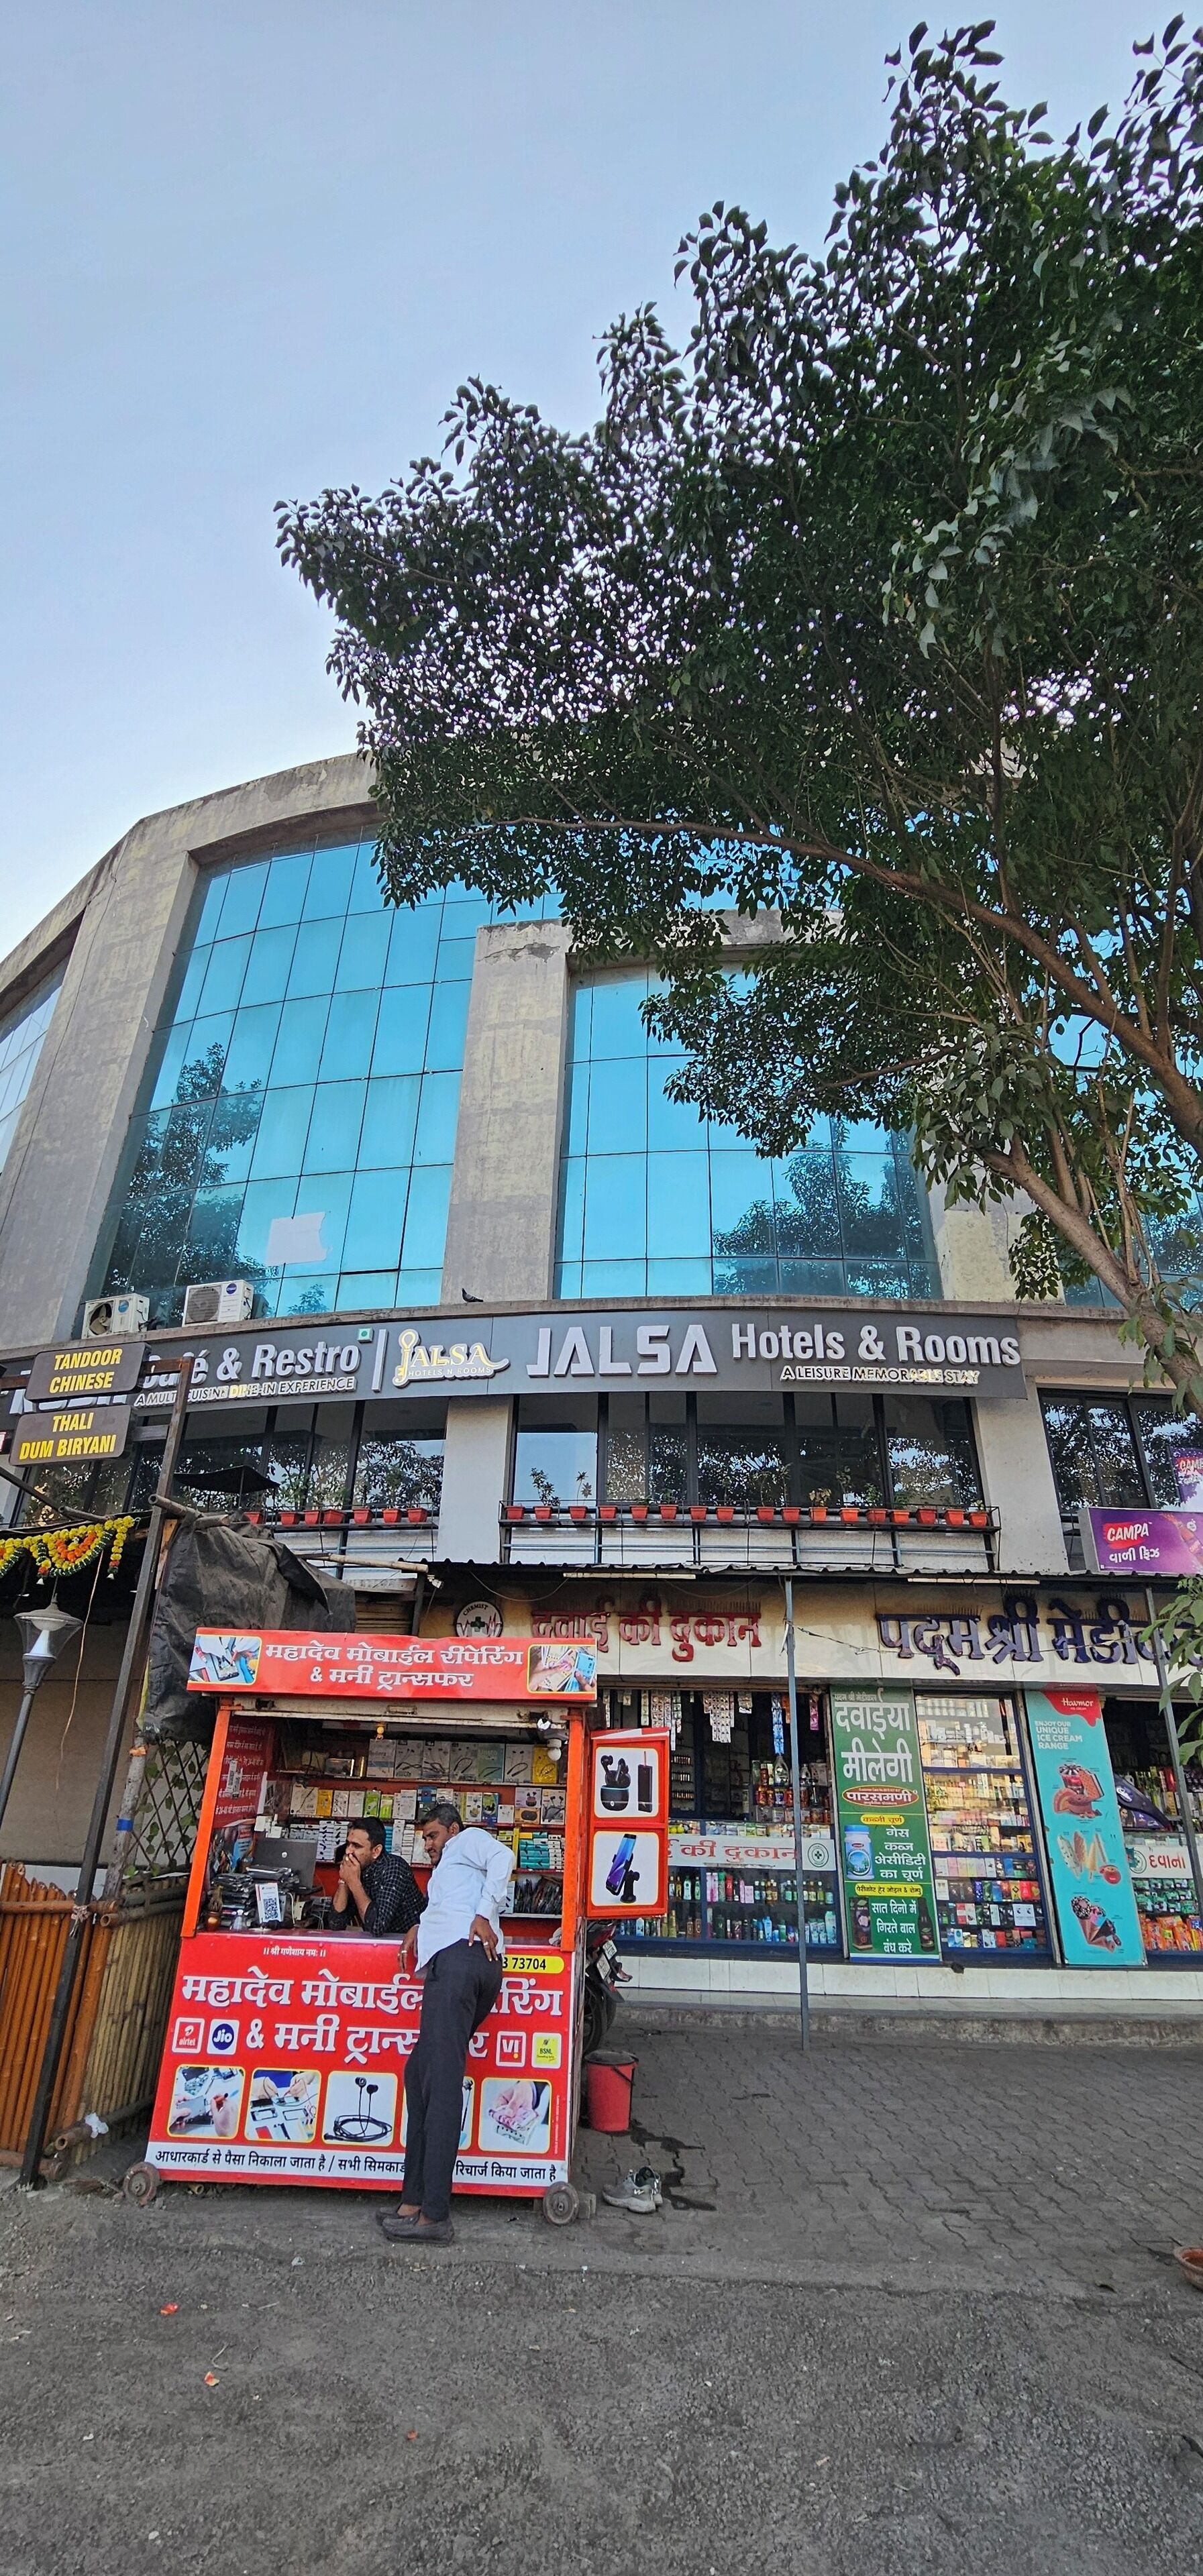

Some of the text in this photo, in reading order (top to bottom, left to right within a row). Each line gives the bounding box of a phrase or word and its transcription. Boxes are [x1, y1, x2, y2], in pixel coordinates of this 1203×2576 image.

[526, 1324, 717, 1378] JALSA
[731, 1324, 1021, 1366] Hotels & Rooms
[54, 1348, 123, 1371] TANDOOR
[217, 1347, 242, 1381] &
[252, 1342, 361, 1379] Restro
[393, 1330, 509, 1386] JALSA
[50, 1371, 115, 1393] CHINESE
[408, 1368, 443, 1377] HOTELS
[457, 1366, 491, 1375] ROOMS
[780, 1365, 795, 1382] A
[796, 1365, 851, 1383] LEISURE
[944, 1371, 980, 1385] STAY
[134, 1393, 148, 1407] A
[148, 1389, 176, 1405] MULT
[278, 1376, 357, 1395] EXPERIENCE
[52, 1412, 95, 1433] THALI
[19, 1434, 117, 1460] DUM BIRYANI
[1107, 1523, 1149, 1542] CAMPA
[619, 1593, 662, 1646] की
[669, 1611, 762, 1662] दुकान
[266, 1640, 524, 1666] महादेव मोबाईल रीपेरिंग
[310, 1665, 474, 1690] & मनी ट्रान्सफर
[1061, 1697, 1094, 1707] Havmor
[1037, 1734, 1083, 1743] ICE CREAM
[841, 1737, 913, 1782] मीलेगी
[680, 1839, 717, 1858] की
[724, 1845, 798, 1864] दुकान
[884, 1842, 913, 1851] कब्ज
[880, 1866, 923, 1882] का चूर्ण
[871, 1902, 888, 1914] सात
[876, 1918, 898, 1933] गिरते
[270, 1945, 280, 1955] श्री
[280, 1946, 305, 1956] गणेशाय
[898, 1938, 912, 1953] करे
[512, 1957, 546, 1970] 73704
[182, 1966, 295, 2008] महादेव
[178, 2037, 196, 2047] airtel
[213, 2030, 233, 2043] Jio
[246, 2019, 264, 2049] &
[274, 2014, 340, 2052] मनी
[539, 2047, 553, 2055] BSNL
[156, 2149, 211, 2164] आधारकार्ड
[212, 2149, 222, 2165] से
[225, 2149, 246, 2165] पैसा
[248, 2151, 287, 2168] निकाला
[290, 2156, 315, 2169] जाता
[318, 2153, 325, 2172] है
[328, 2155, 335, 2173] /
[337, 2155, 361, 2171] सभी
[456, 2160, 488, 2178] रिचार्ज
[491, 2161, 517, 2178] किया
[520, 2166, 547, 2180] जाता
[549, 2164, 557, 2182] है
